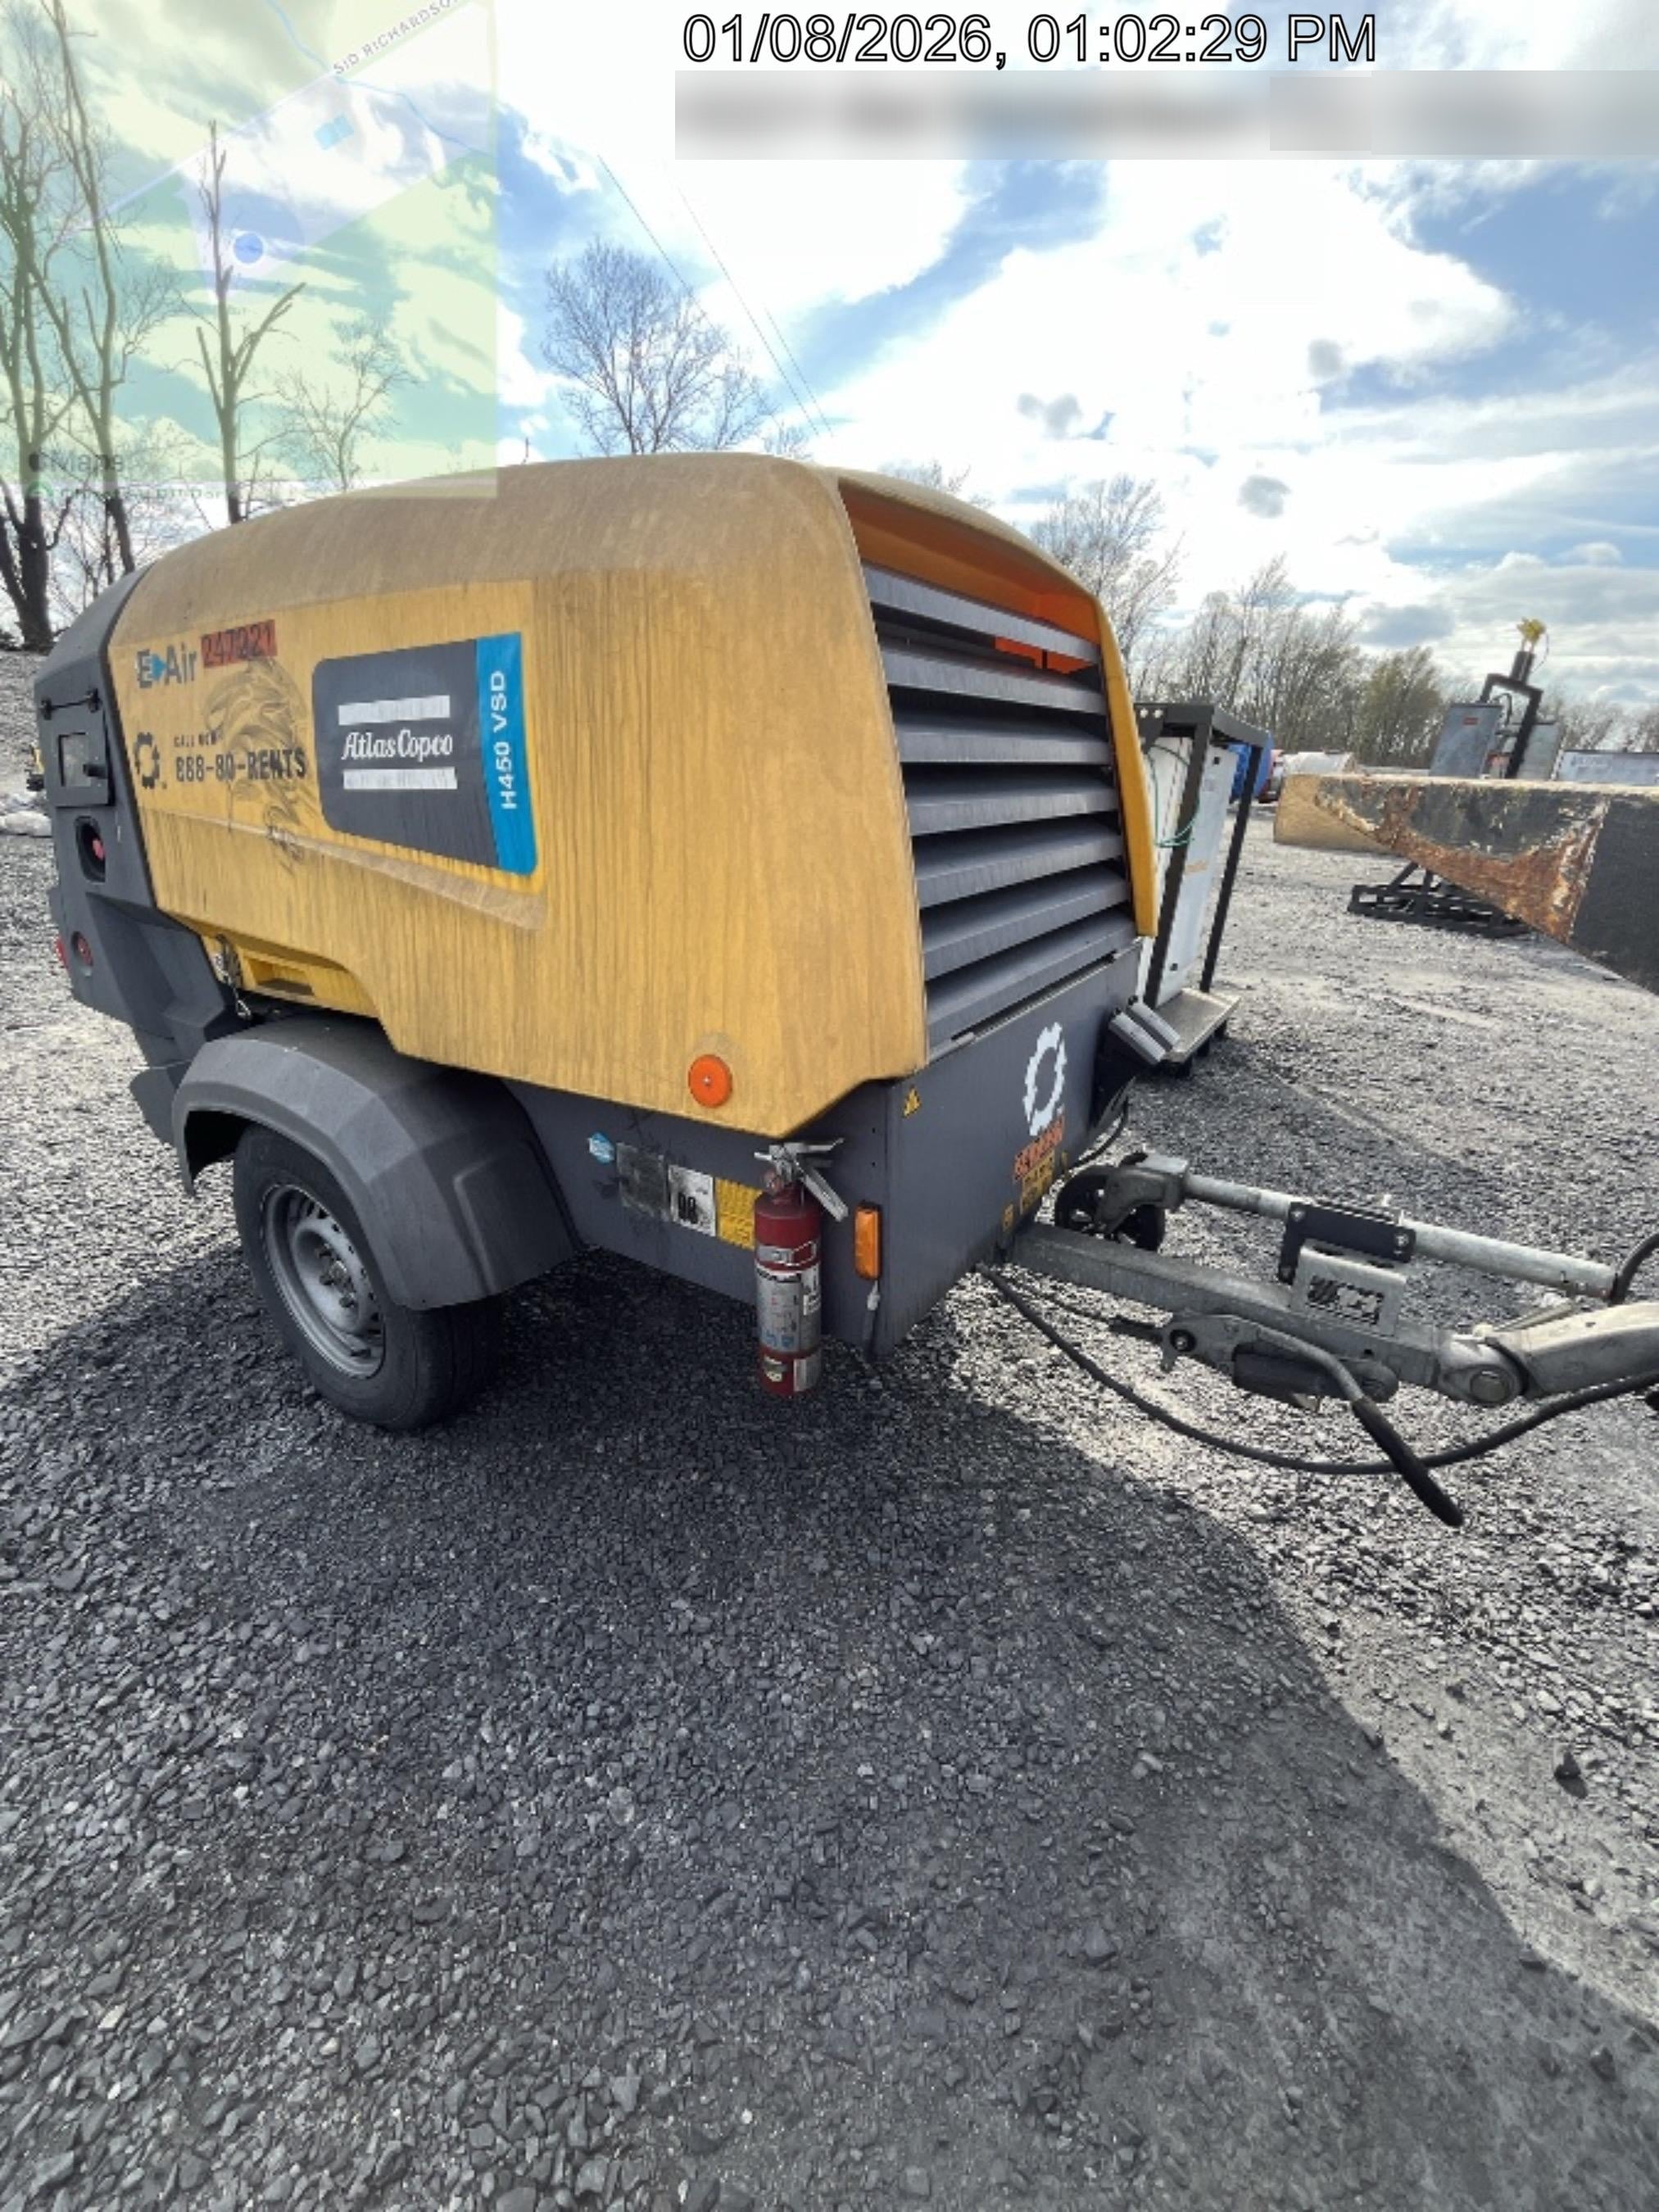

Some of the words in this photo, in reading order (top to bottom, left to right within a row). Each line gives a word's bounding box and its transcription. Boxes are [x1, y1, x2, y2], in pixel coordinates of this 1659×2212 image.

[491, 670, 507, 733] VSD
[341, 732, 396, 760] Atlas
[397, 728, 453, 763] Copco
[492, 741, 517, 809] H450
